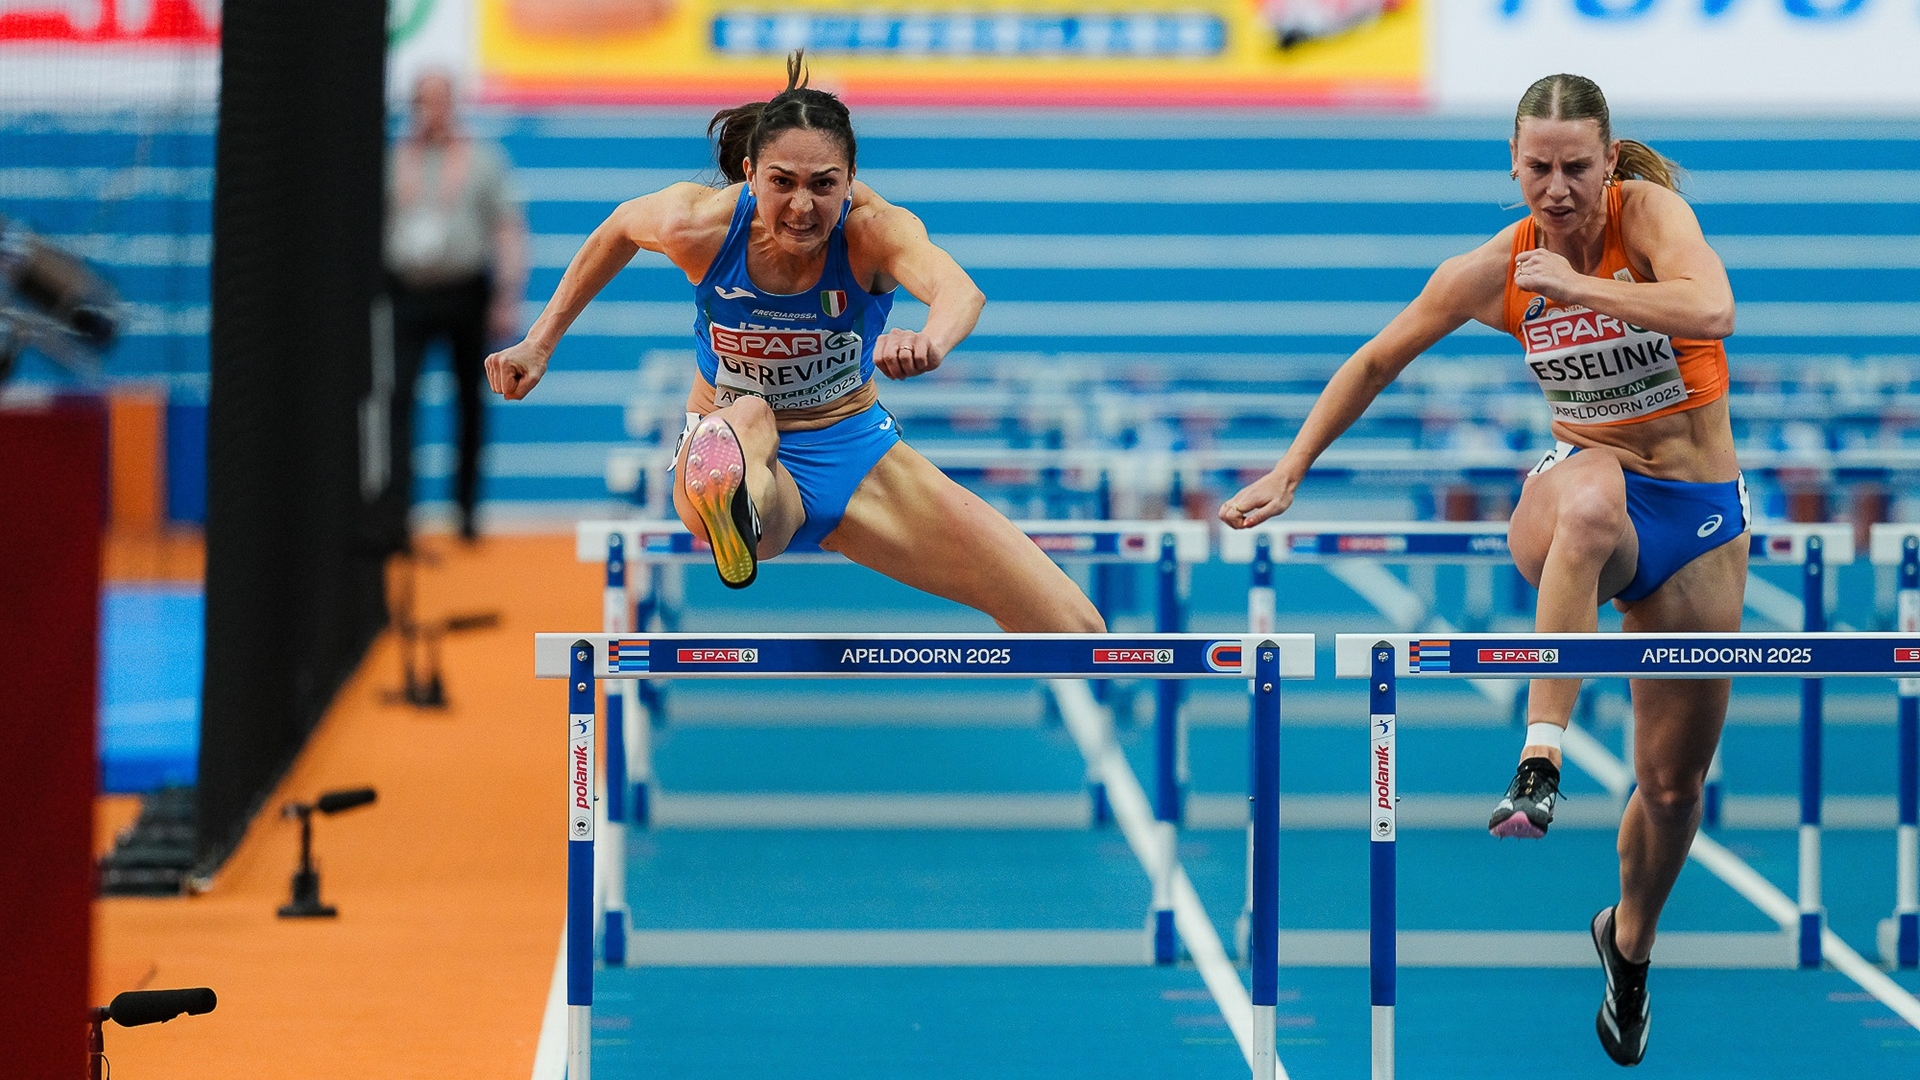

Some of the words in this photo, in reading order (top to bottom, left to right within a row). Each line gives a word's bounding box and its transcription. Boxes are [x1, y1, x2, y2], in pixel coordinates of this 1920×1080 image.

[752, 308, 818, 319] FRECCIAROSSA
[1529, 314, 1621, 350] SPAR
[715, 332, 818, 356] SPAR
[721, 348, 856, 387] GEREVINI
[1530, 338, 1670, 382] ESSELINK
[785, 380, 828, 400] CLEAN
[824, 375, 856, 400] 2025
[1570, 391, 1575, 401] I
[1575, 391, 1602, 402] RUN
[1604, 380, 1647, 400] CLEAN
[1555, 399, 1643, 419] APELDOORN
[1645, 385, 1681, 407] 2025
[692, 651, 739, 661] SPAR
[841, 648, 961, 664] APELDOORN
[967, 648, 1011, 664] 2025
[1107, 651, 1155, 661] SPAR
[1492, 651, 1540, 661] SPAR
[1642, 648, 1762, 664] APELDOORN
[1768, 648, 1812, 664] 2025
[573, 744, 590, 810] polanik
[1375, 744, 1392, 810] polanik
